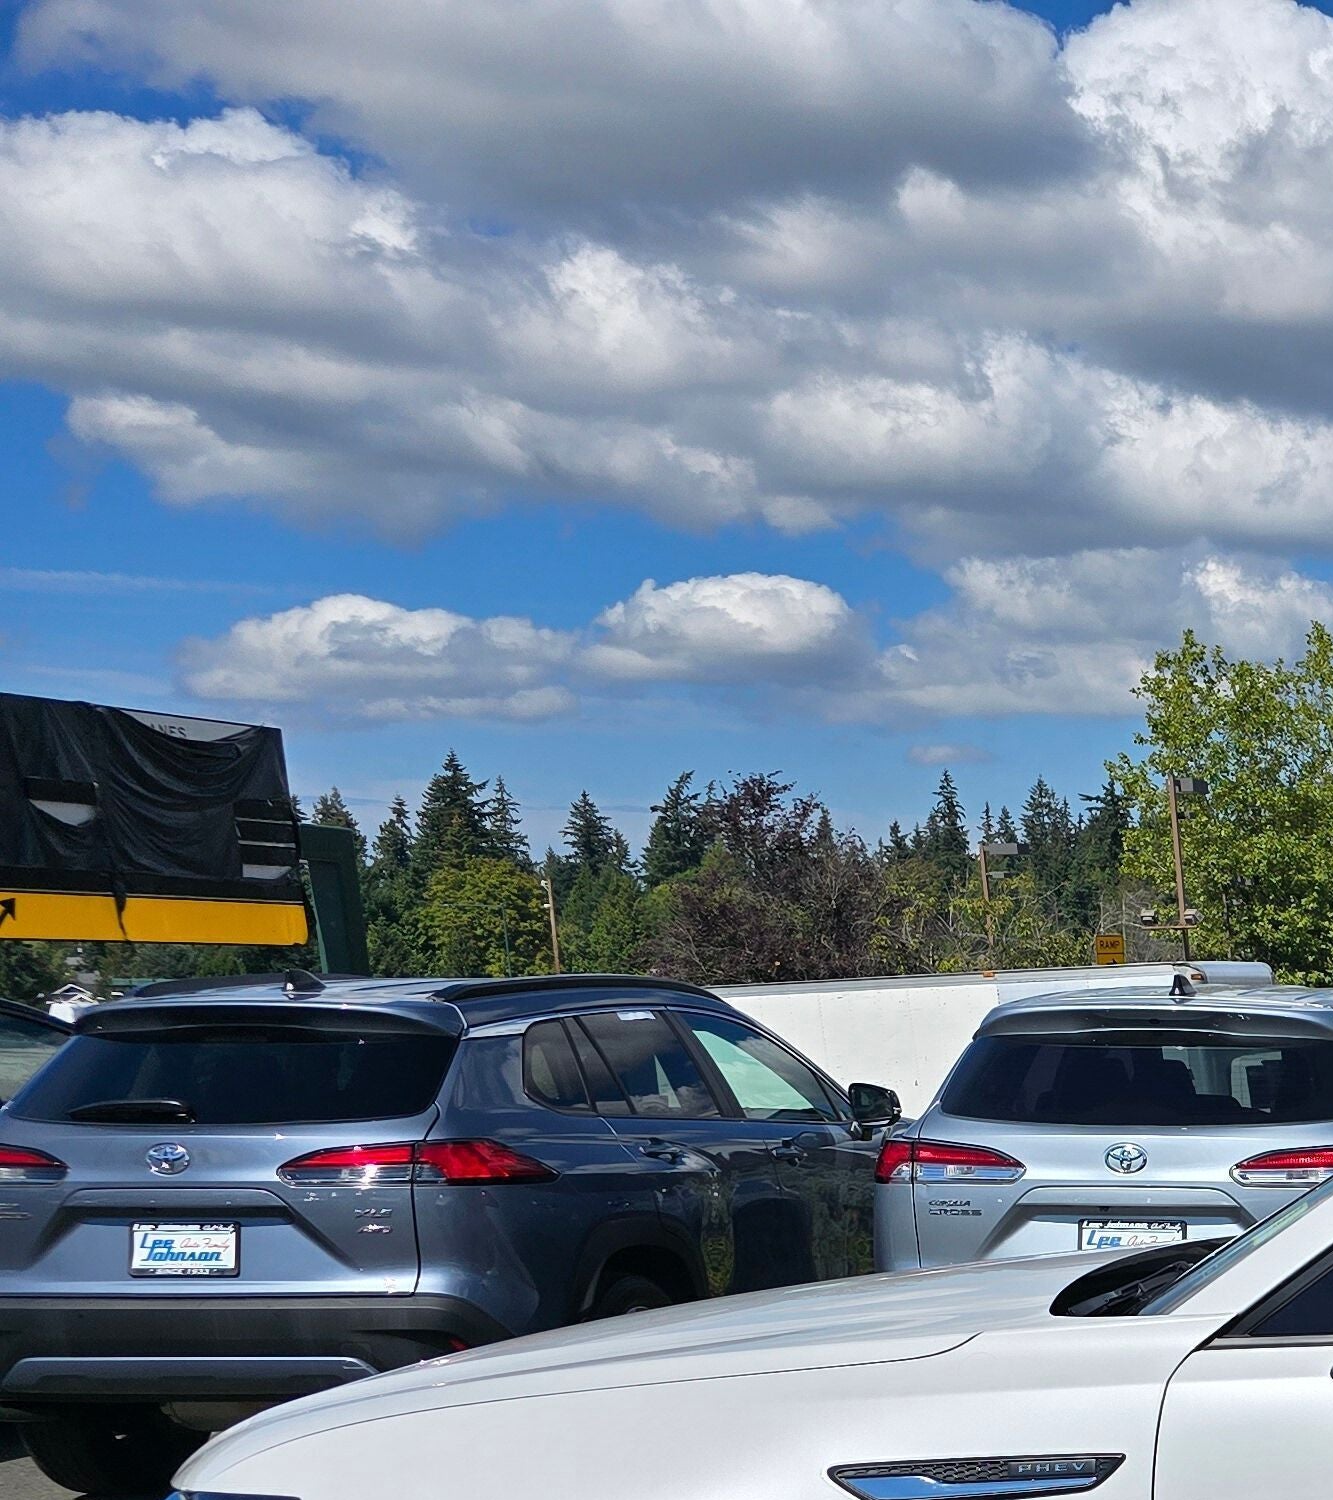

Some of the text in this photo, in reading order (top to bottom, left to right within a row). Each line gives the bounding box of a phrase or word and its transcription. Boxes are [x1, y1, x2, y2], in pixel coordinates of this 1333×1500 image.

[1100, 940, 1121, 949] RAMP
[140, 1232, 176, 1249] Lee
[1087, 1230, 1122, 1248] Lee
[140, 1247, 225, 1261] Johnson
[1018, 1462, 1086, 1473] PHEV
